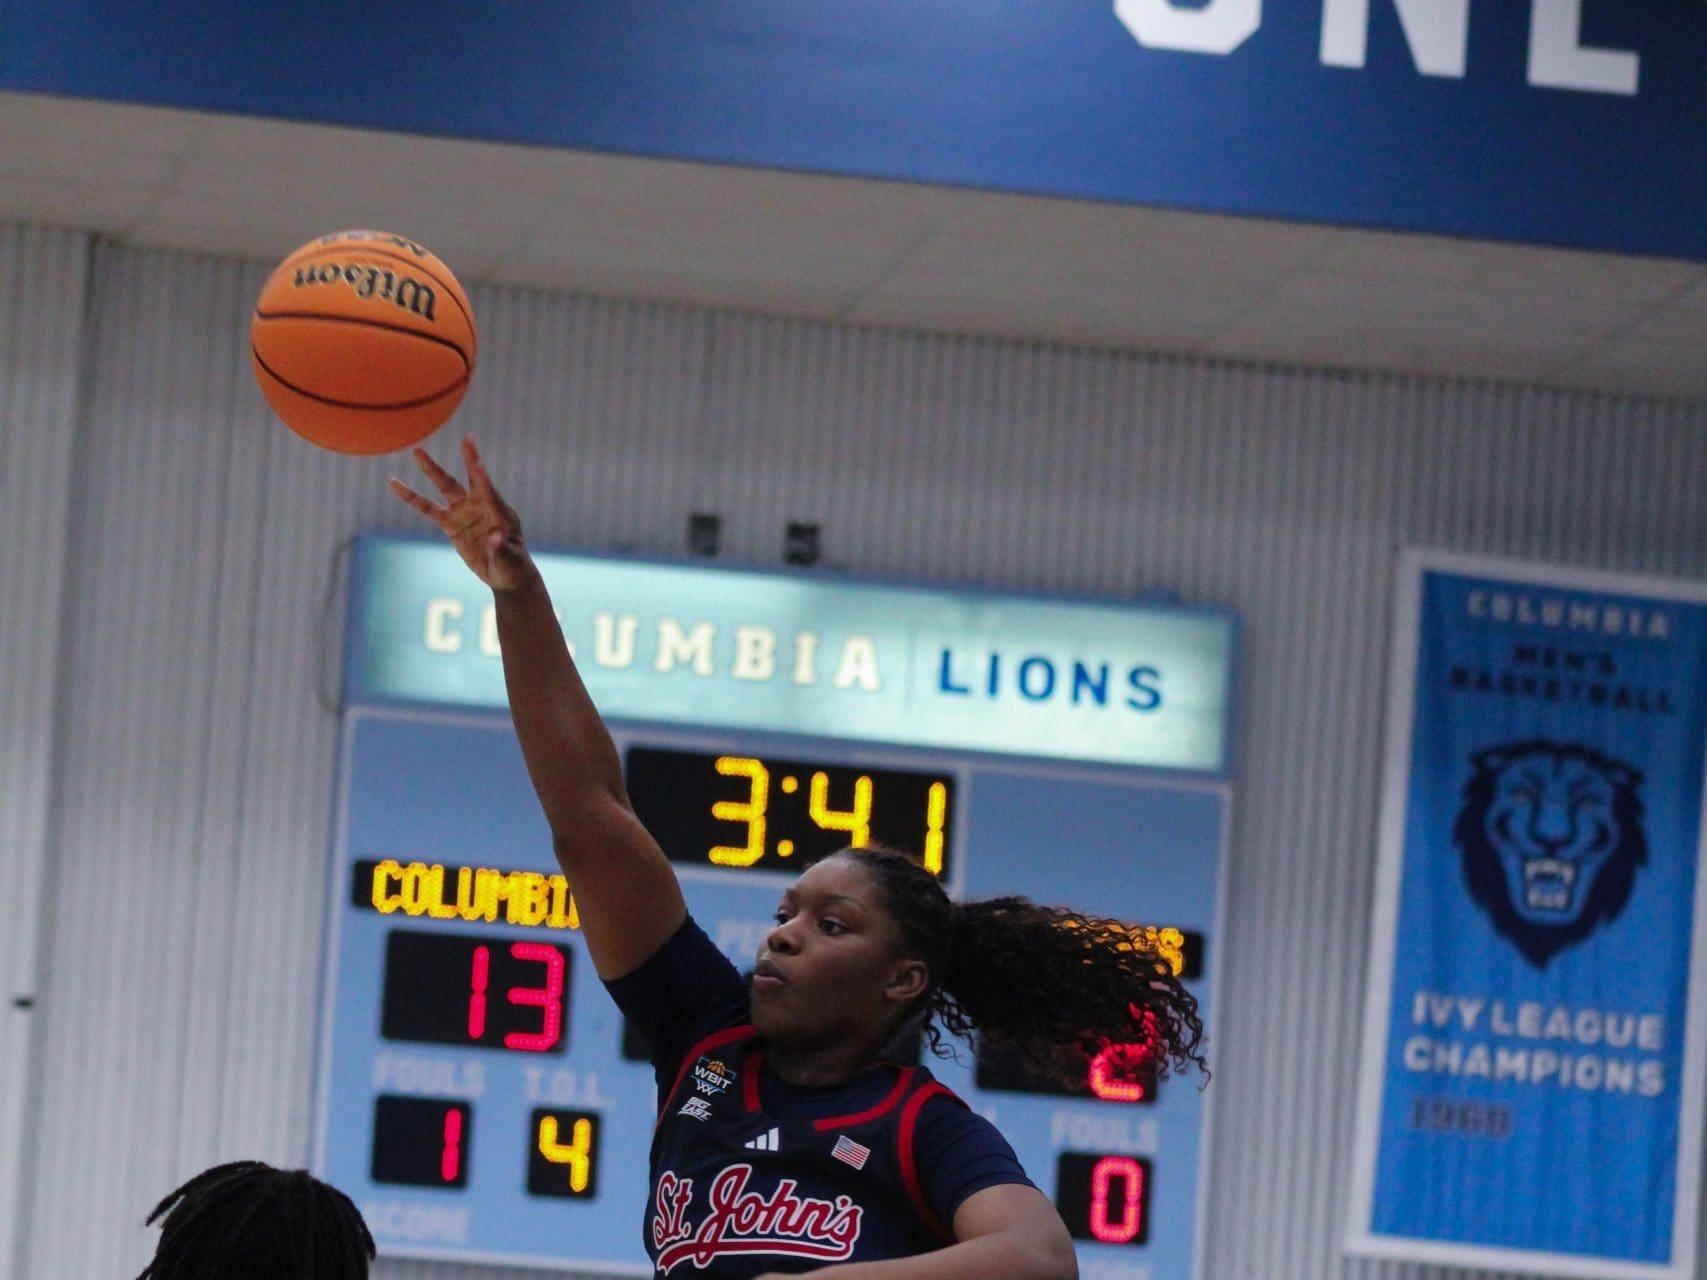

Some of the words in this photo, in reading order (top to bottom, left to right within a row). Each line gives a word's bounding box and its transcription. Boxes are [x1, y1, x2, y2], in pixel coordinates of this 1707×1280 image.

[292, 262, 436, 323] Wilson
[1466, 590, 1670, 641] COLUMBIA
[424, 597, 881, 692] CUMBIA
[938, 647, 1163, 710] LIONS
[709, 756, 948, 877] 3:41
[468, 941, 565, 1053] 13
[1411, 989, 1483, 1033] IVY
[1491, 1001, 1665, 1051] LEAGUE
[695, 1065, 732, 1089] WBIT
[1403, 1034, 1666, 1098] CHAMPIONS
[681, 1103, 712, 1120] EAST
[688, 1096, 712, 1110] BIG
[441, 1108, 463, 1182] 1
[538, 1115, 592, 1193] 4
[653, 1170, 693, 1250] St.
[694, 1162, 864, 1270] John's
[1089, 1155, 1143, 1244] 0
